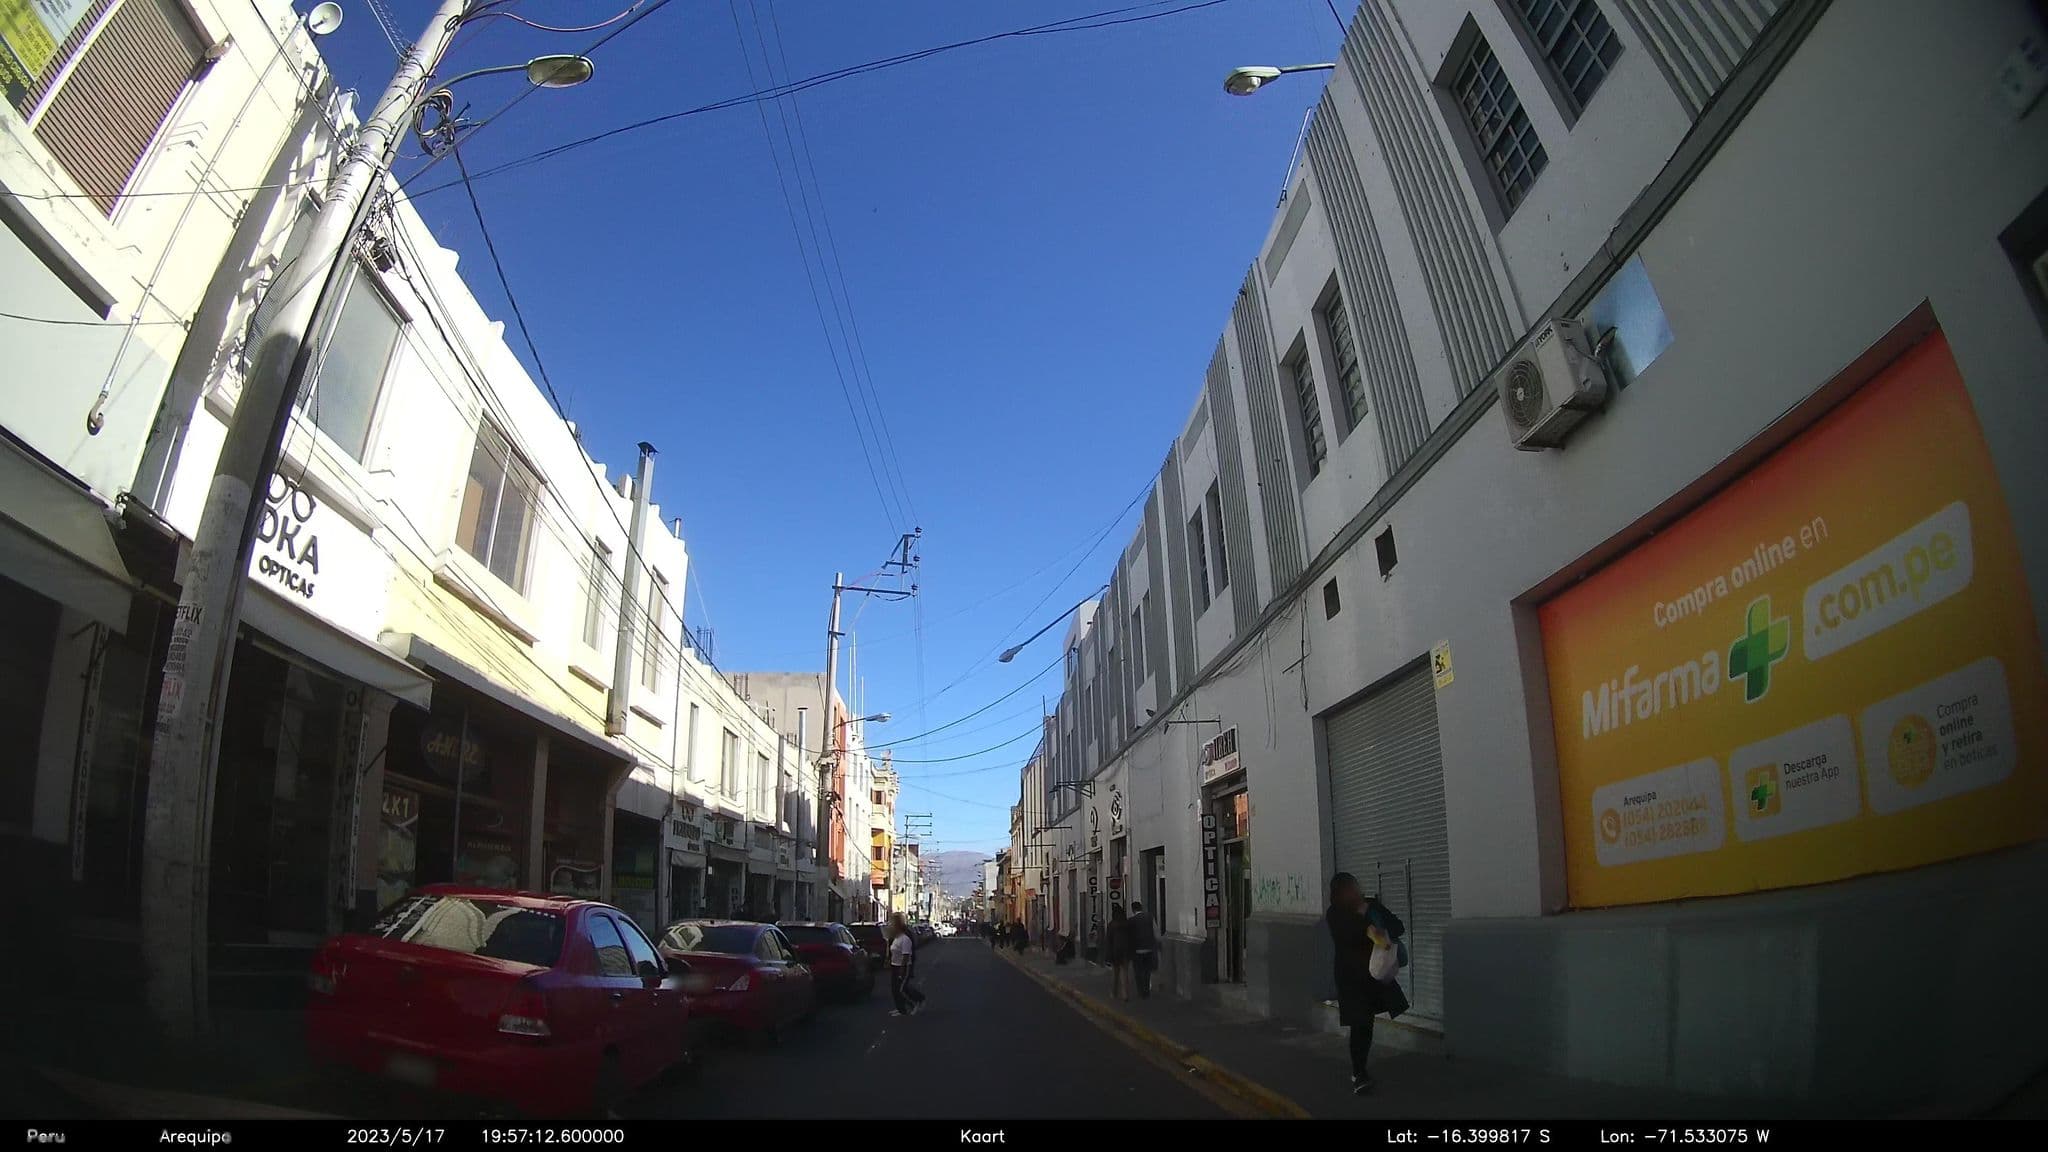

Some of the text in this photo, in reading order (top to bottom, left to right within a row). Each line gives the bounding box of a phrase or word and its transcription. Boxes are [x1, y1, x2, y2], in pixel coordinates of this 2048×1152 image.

[259, 555, 315, 599] OPTICAS
[1653, 515, 1828, 630] Compra online en
[1813, 531, 1957, 635] .com.pe
[1582, 649, 1721, 738] Mifarma
[1936, 694, 1978, 719] Compra
[1939, 715, 1974, 737] online
[1942, 730, 1983, 757] y retira
[1784, 753, 1827, 775] Descarga
[1785, 764, 1840, 790] nuestra App
[1624, 792, 1657, 807] Arequipa
[1203, 815, 1219, 907] OPTICA
[1089, 877, 1098, 932] OPTICA
